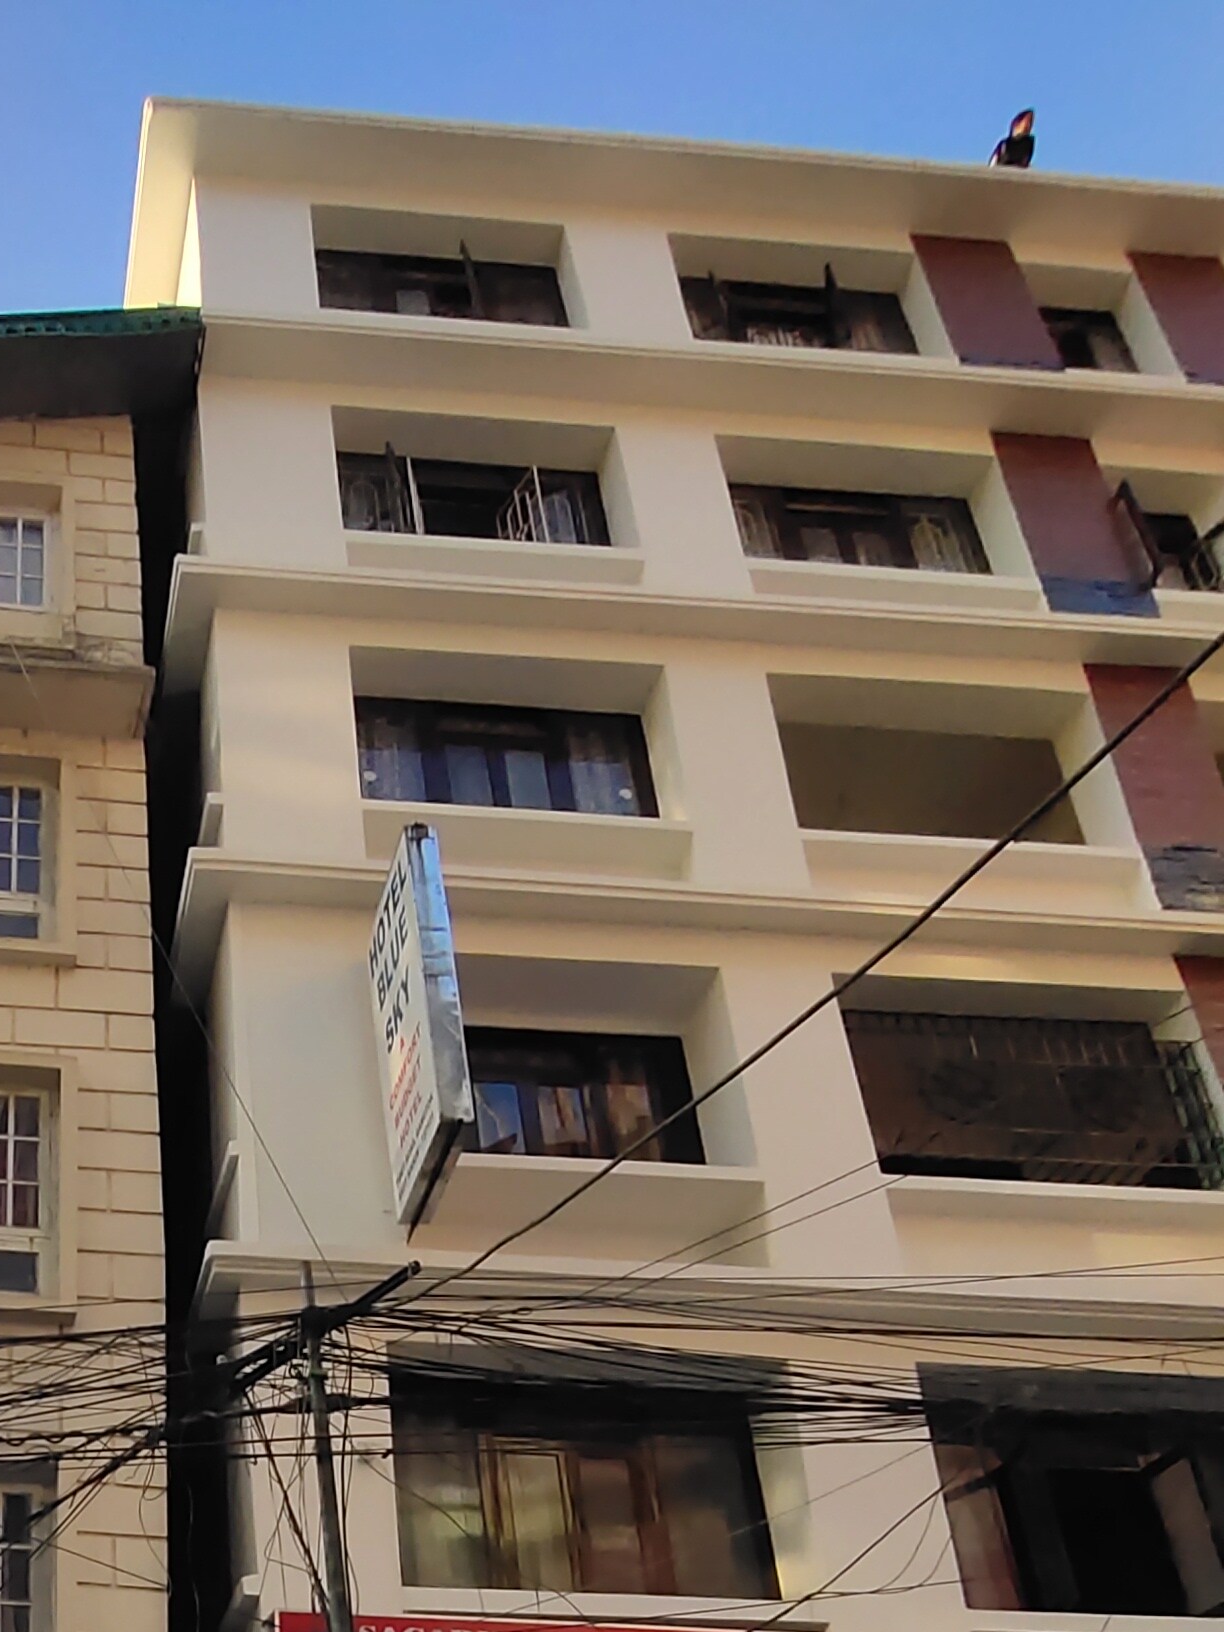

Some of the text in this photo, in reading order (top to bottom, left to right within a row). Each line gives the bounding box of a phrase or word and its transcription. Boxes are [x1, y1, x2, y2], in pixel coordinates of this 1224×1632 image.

[368, 859, 407, 978] HOTEL
[376, 903, 409, 1013] BLUE
[385, 964, 411, 1054] SKY
[389, 1020, 422, 1111] COMFORT
[394, 1053, 422, 1130] BUDGET
[399, 1091, 423, 1149] HOTEL
